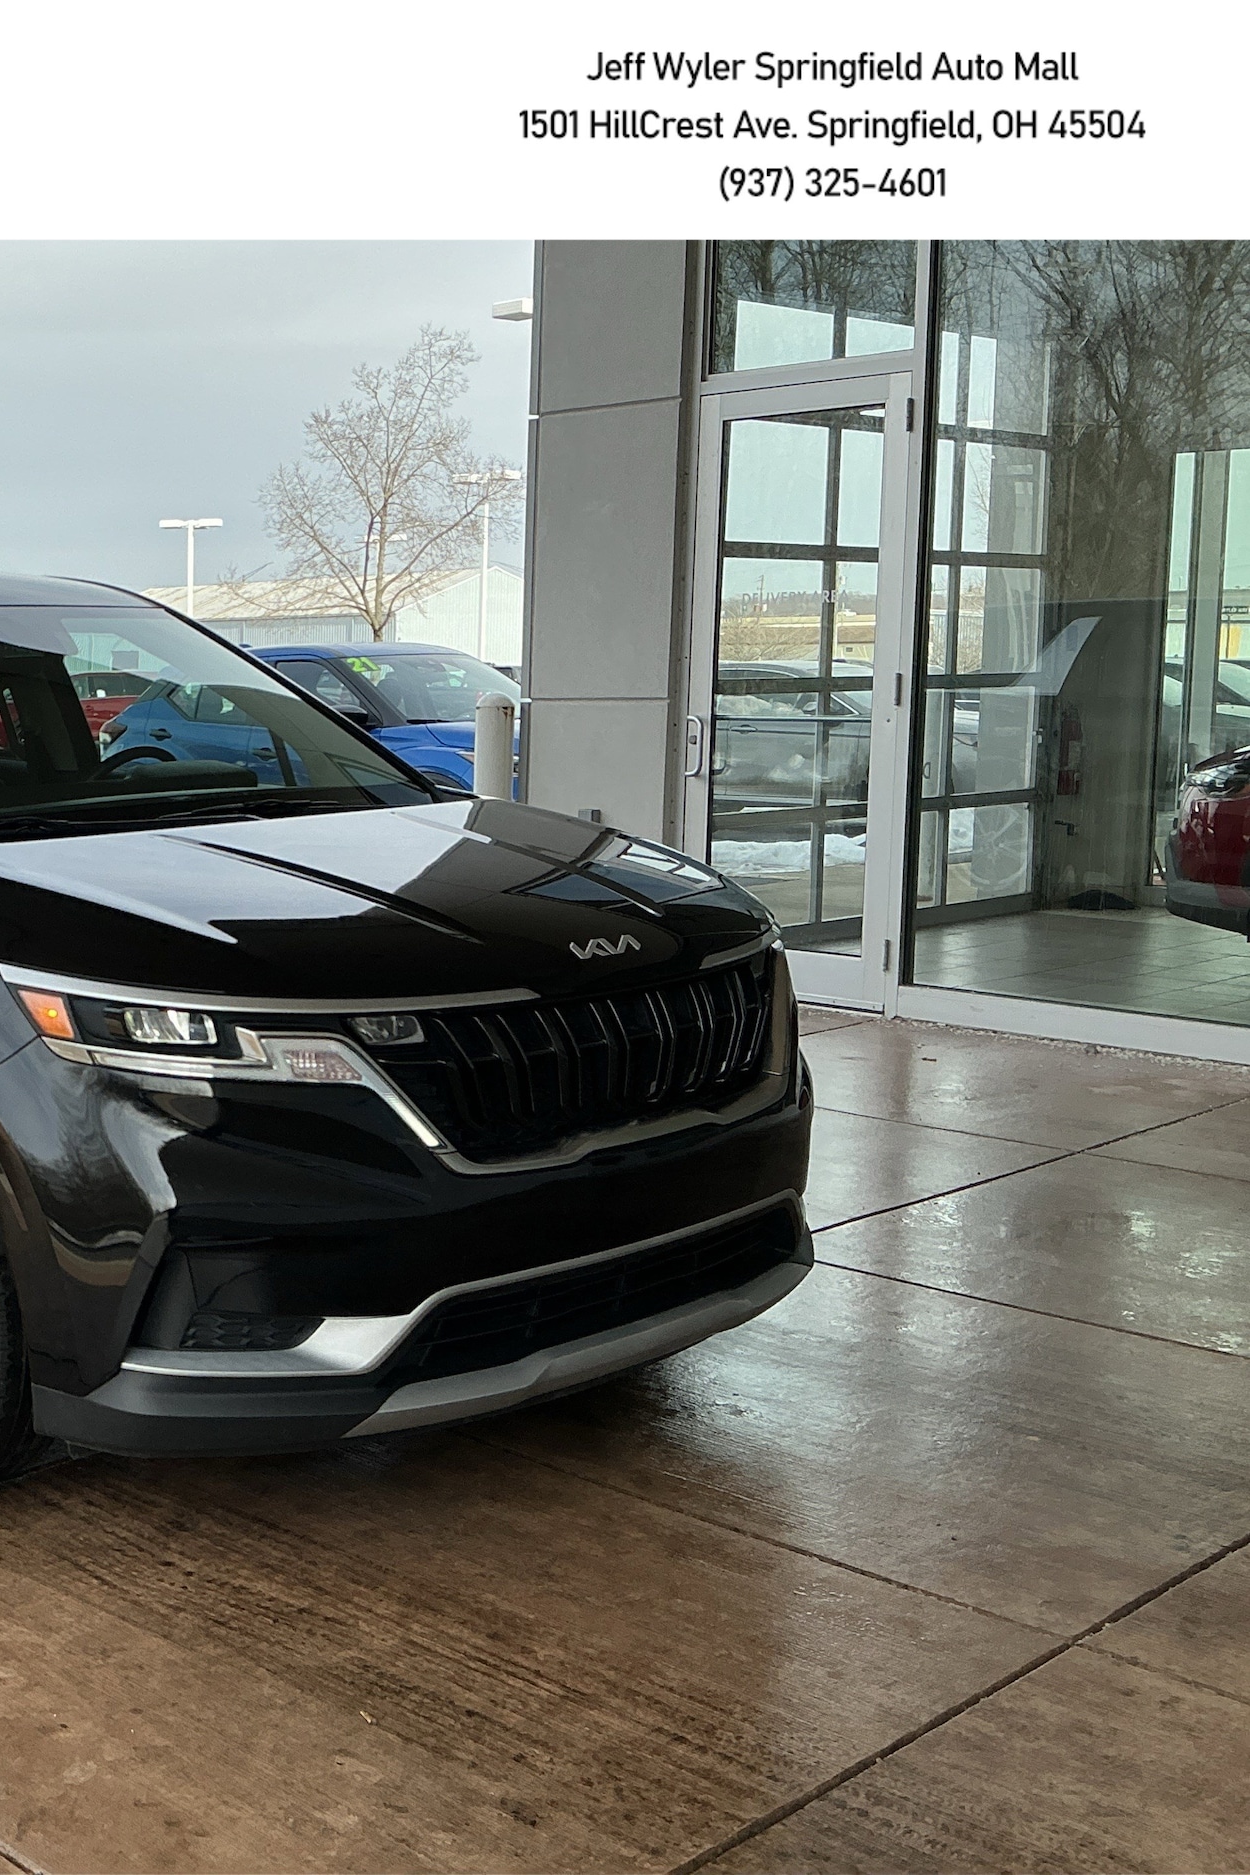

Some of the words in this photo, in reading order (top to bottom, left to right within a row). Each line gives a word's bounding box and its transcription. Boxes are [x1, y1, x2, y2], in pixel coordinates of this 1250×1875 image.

[741, 590, 807, 606] DELIVERY
[812, 589, 849, 604] AREA
[346, 656, 381, 673] 21
[569, 933, 642, 960] KIA
